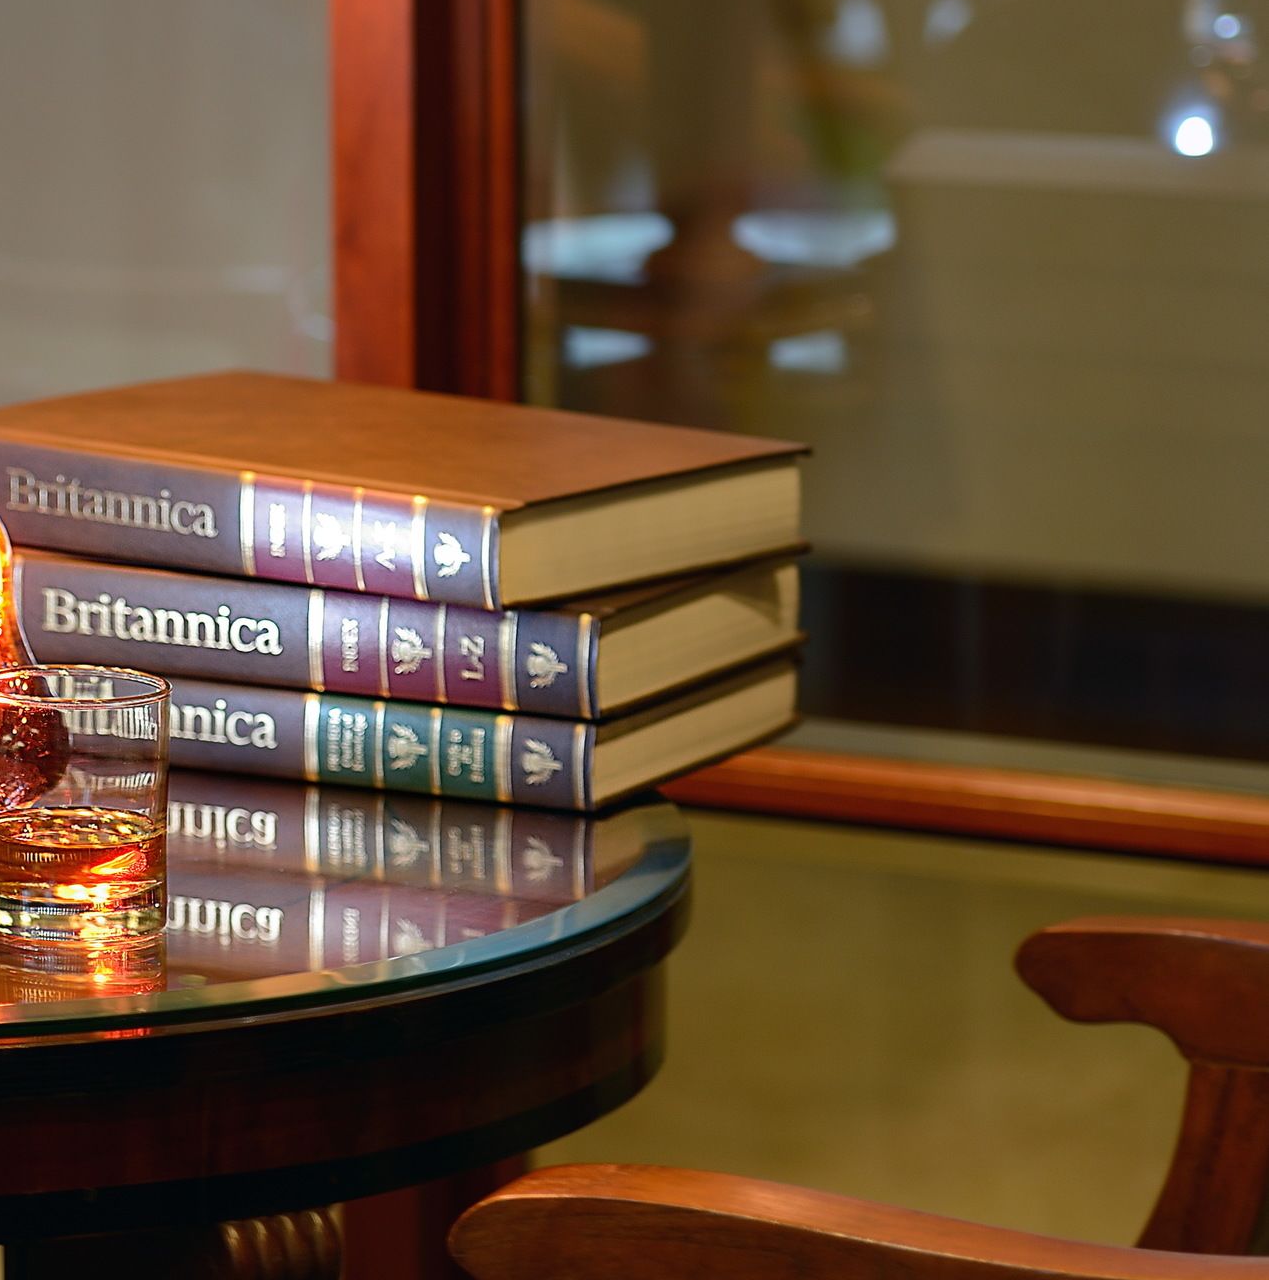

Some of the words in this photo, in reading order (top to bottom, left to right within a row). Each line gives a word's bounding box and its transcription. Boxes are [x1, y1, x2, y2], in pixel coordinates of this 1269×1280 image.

[6, 467, 218, 539] Britannica
[42, 588, 283, 656] Britannica
[340, 618, 359, 673] INDEX
[458, 635, 486, 681] L-Z
